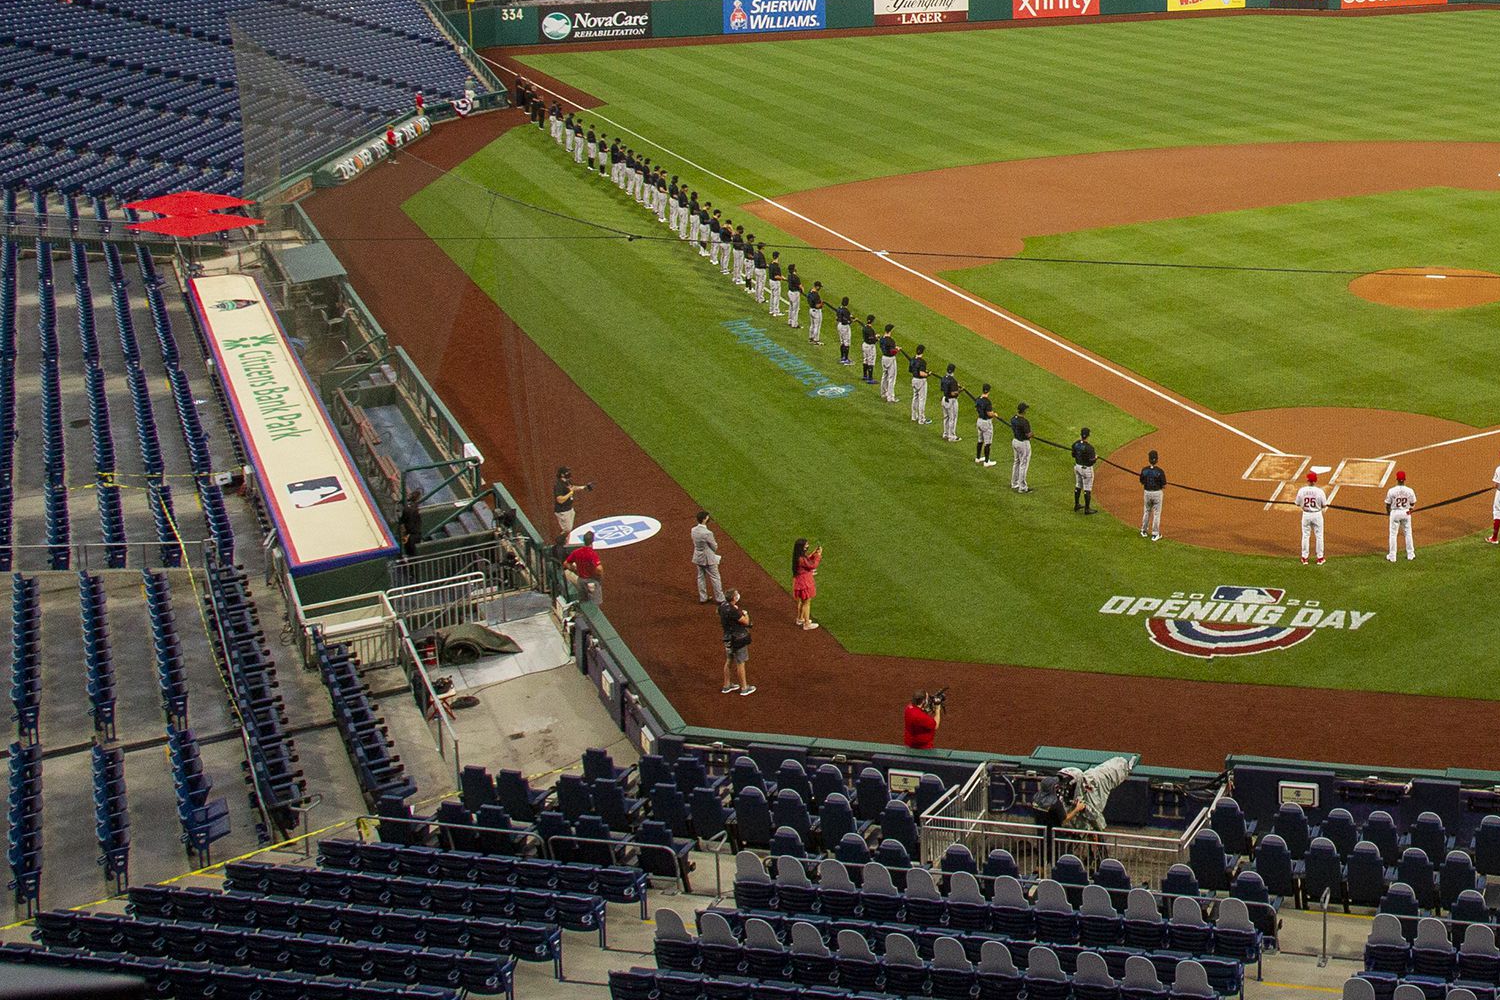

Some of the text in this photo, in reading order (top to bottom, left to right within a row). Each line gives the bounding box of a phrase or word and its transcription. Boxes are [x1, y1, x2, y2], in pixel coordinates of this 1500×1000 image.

[501, 8, 523, 21] 334
[572, 11, 648, 29] NovaCare
[901, 12, 943, 24] LAGER
[573, 28, 645, 38] REHABILITATION
[237, 348, 312, 441] Citizens Bank Park
[1304, 498, 1316, 508] 25
[1396, 498, 1407, 508] 22
[1099, 595, 1376, 630] OPENING DAY
